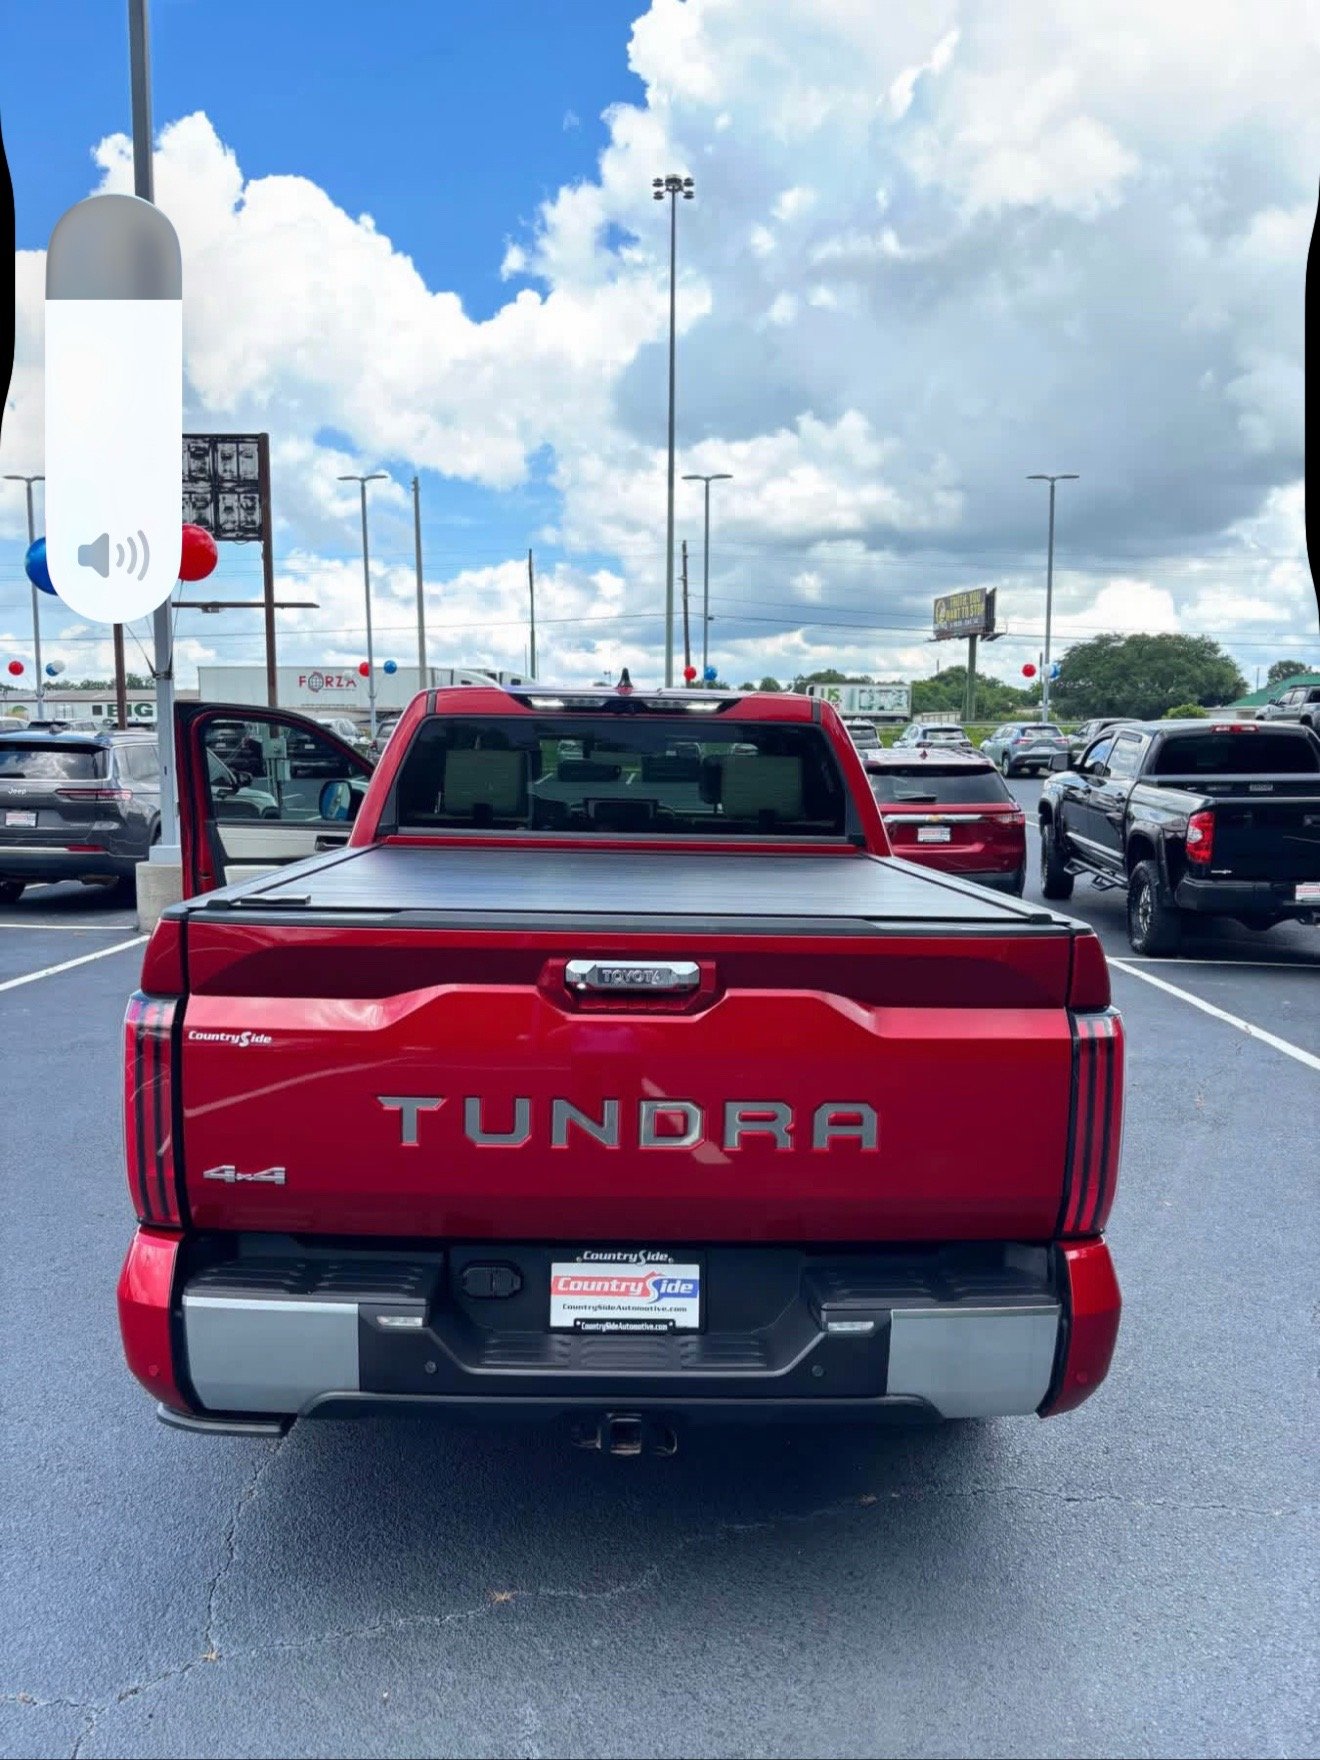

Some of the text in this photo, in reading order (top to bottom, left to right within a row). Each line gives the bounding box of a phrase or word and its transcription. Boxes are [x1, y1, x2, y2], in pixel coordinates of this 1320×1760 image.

[298, 671, 357, 693] FORZA
[602, 970, 660, 984] TOYOTA
[188, 1030, 272, 1047] CountrySide
[378, 1097, 879, 1151] TUNDRA
[583, 1250, 668, 1266] CountrySide
[557, 1275, 693, 1303] CountrySide
